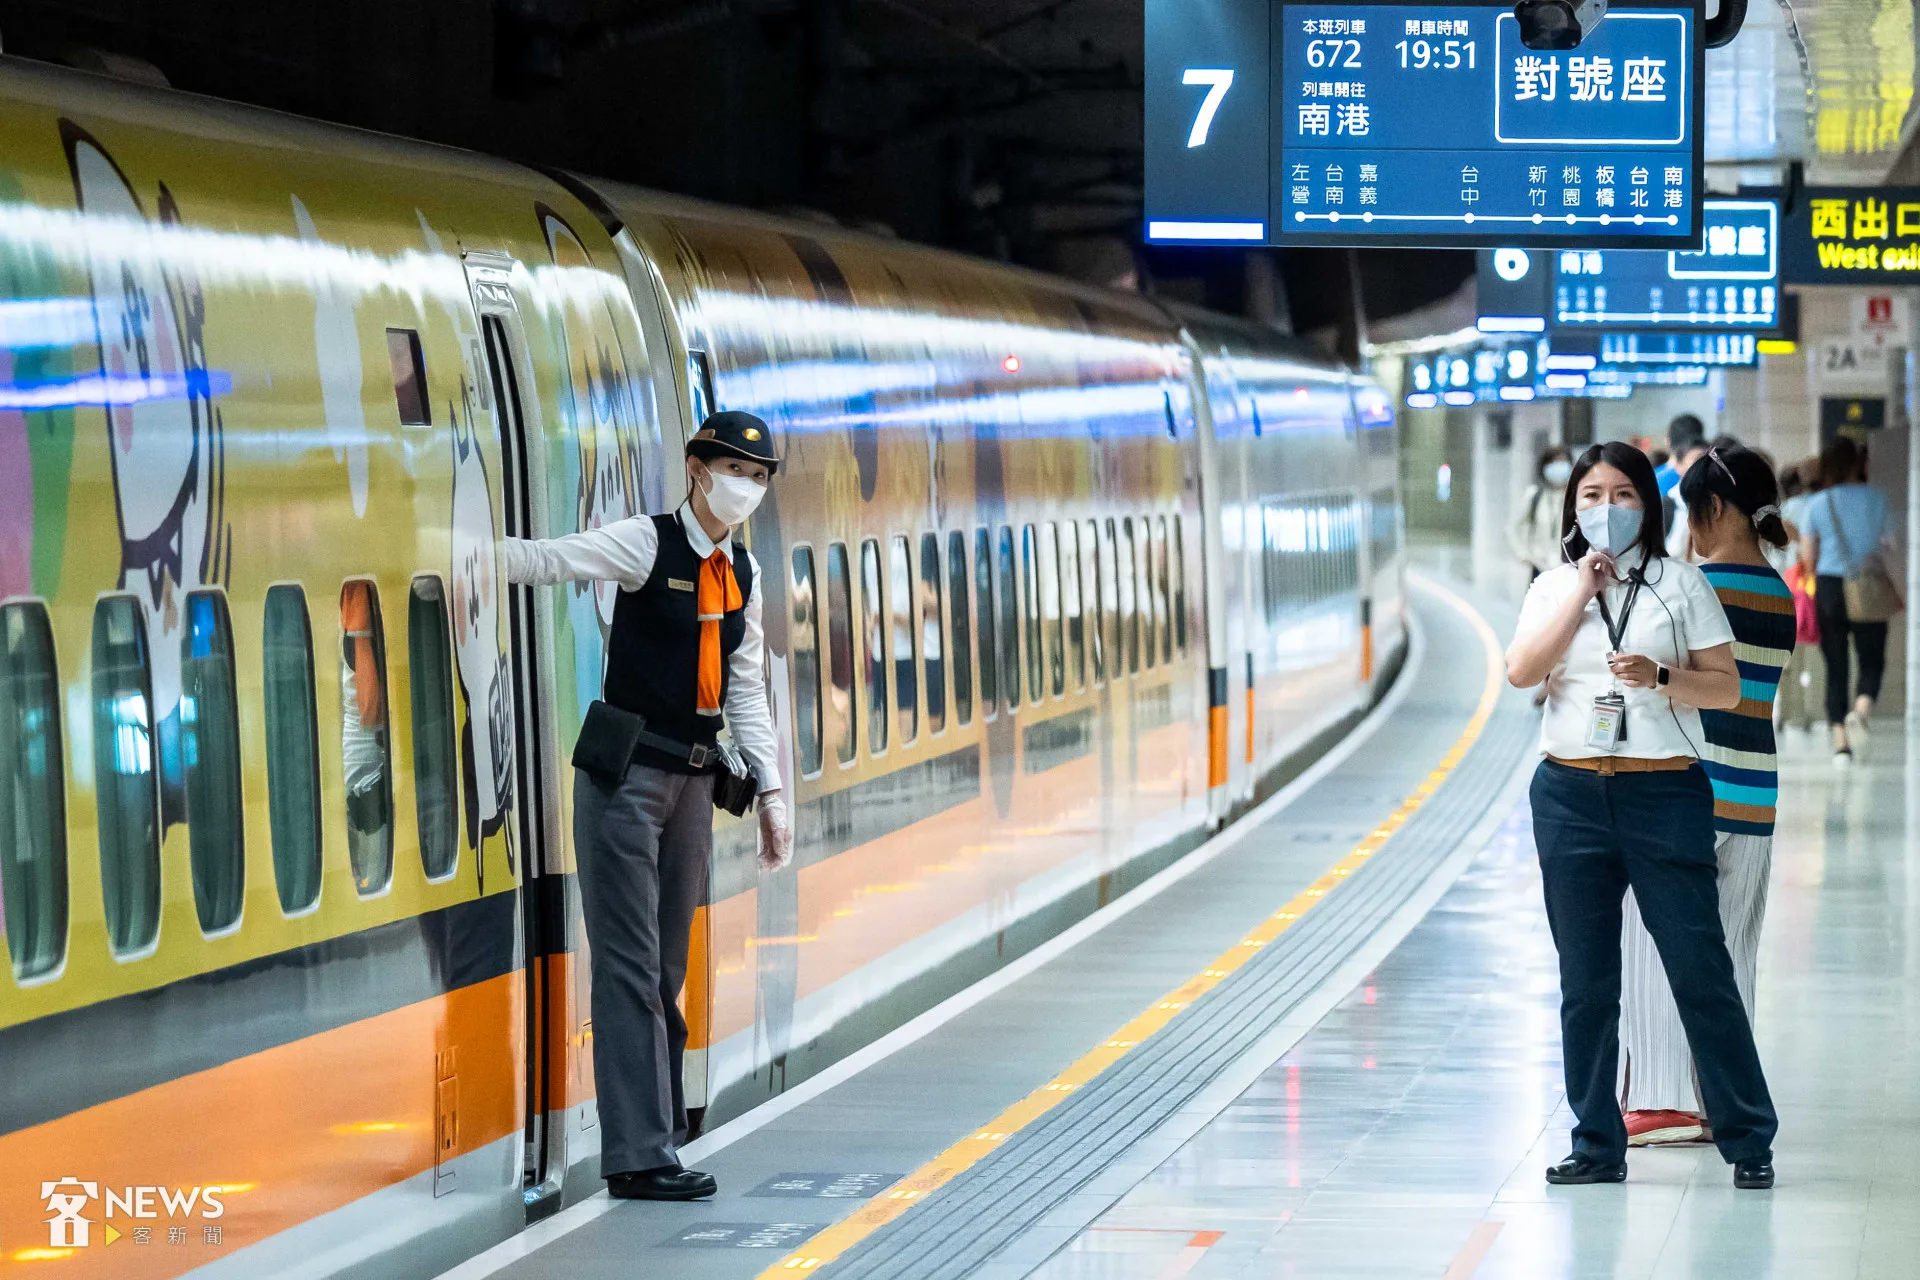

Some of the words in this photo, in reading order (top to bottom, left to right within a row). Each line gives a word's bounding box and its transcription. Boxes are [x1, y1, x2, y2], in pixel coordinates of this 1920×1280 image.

[1302, 19, 1366, 35] 本班列車
[1405, 19, 1469, 36] 開車時間
[1306, 39, 1362, 68] 672
[1395, 40, 1476, 69] 19:51
[1302, 81, 1366, 98] 列車開往
[1514, 55, 1667, 102] 對號座
[1181, 69, 1235, 149] 7
[1298, 102, 1370, 136] 南港
[1291, 162, 1310, 204] 左營
[1325, 163, 1344, 205] 台南
[1359, 163, 1378, 205] 嘉義
[1461, 165, 1480, 206] 台中
[1528, 165, 1548, 206] 新竹
[1562, 165, 1582, 207] 桃園
[1595, 165, 1615, 208] 板橋
[1630, 165, 1649, 208] 台北
[1663, 166, 1683, 208] 南港
[1810, 197, 1920, 239] 西出口
[1818, 242, 1878, 269] West
[1882, 242, 1920, 270] exi
